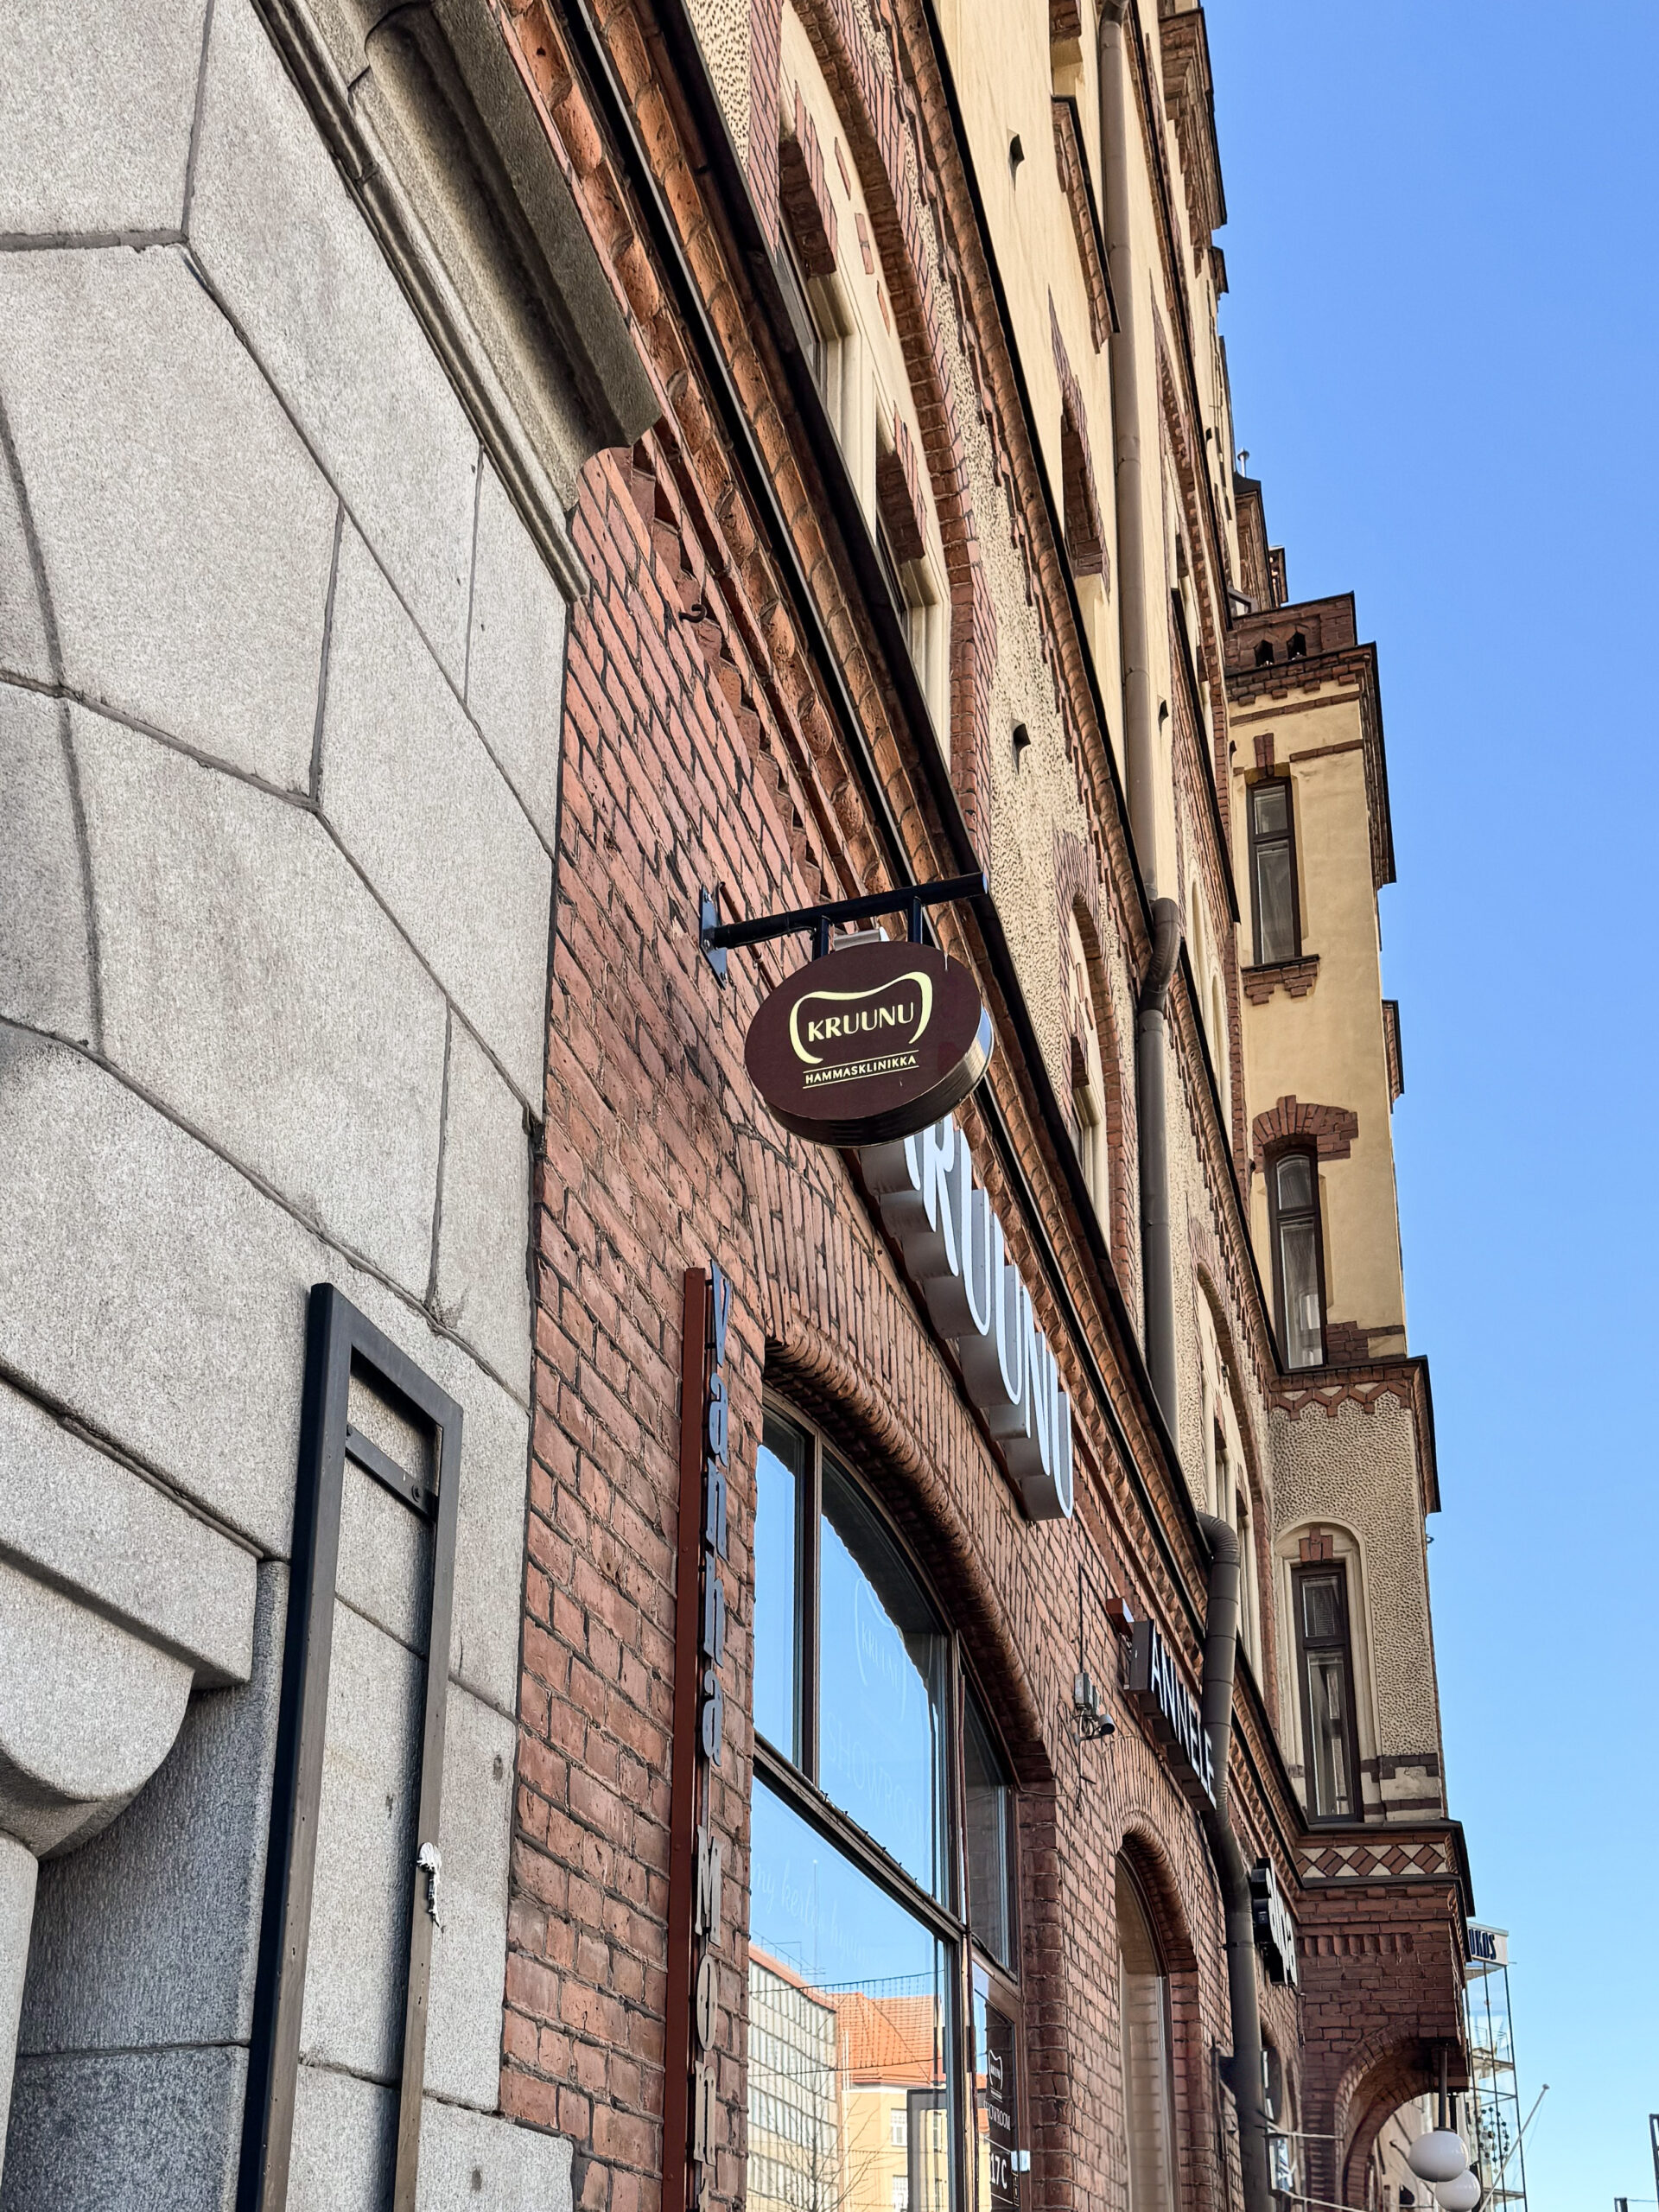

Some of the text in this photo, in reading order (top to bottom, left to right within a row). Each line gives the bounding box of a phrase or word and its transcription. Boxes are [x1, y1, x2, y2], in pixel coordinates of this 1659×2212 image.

[807, 1002, 915, 1042] KRUUNU
[805, 1055, 917, 1084] HAMMASKLINIKKA
[990, 2153, 1007, 2190] 17C
